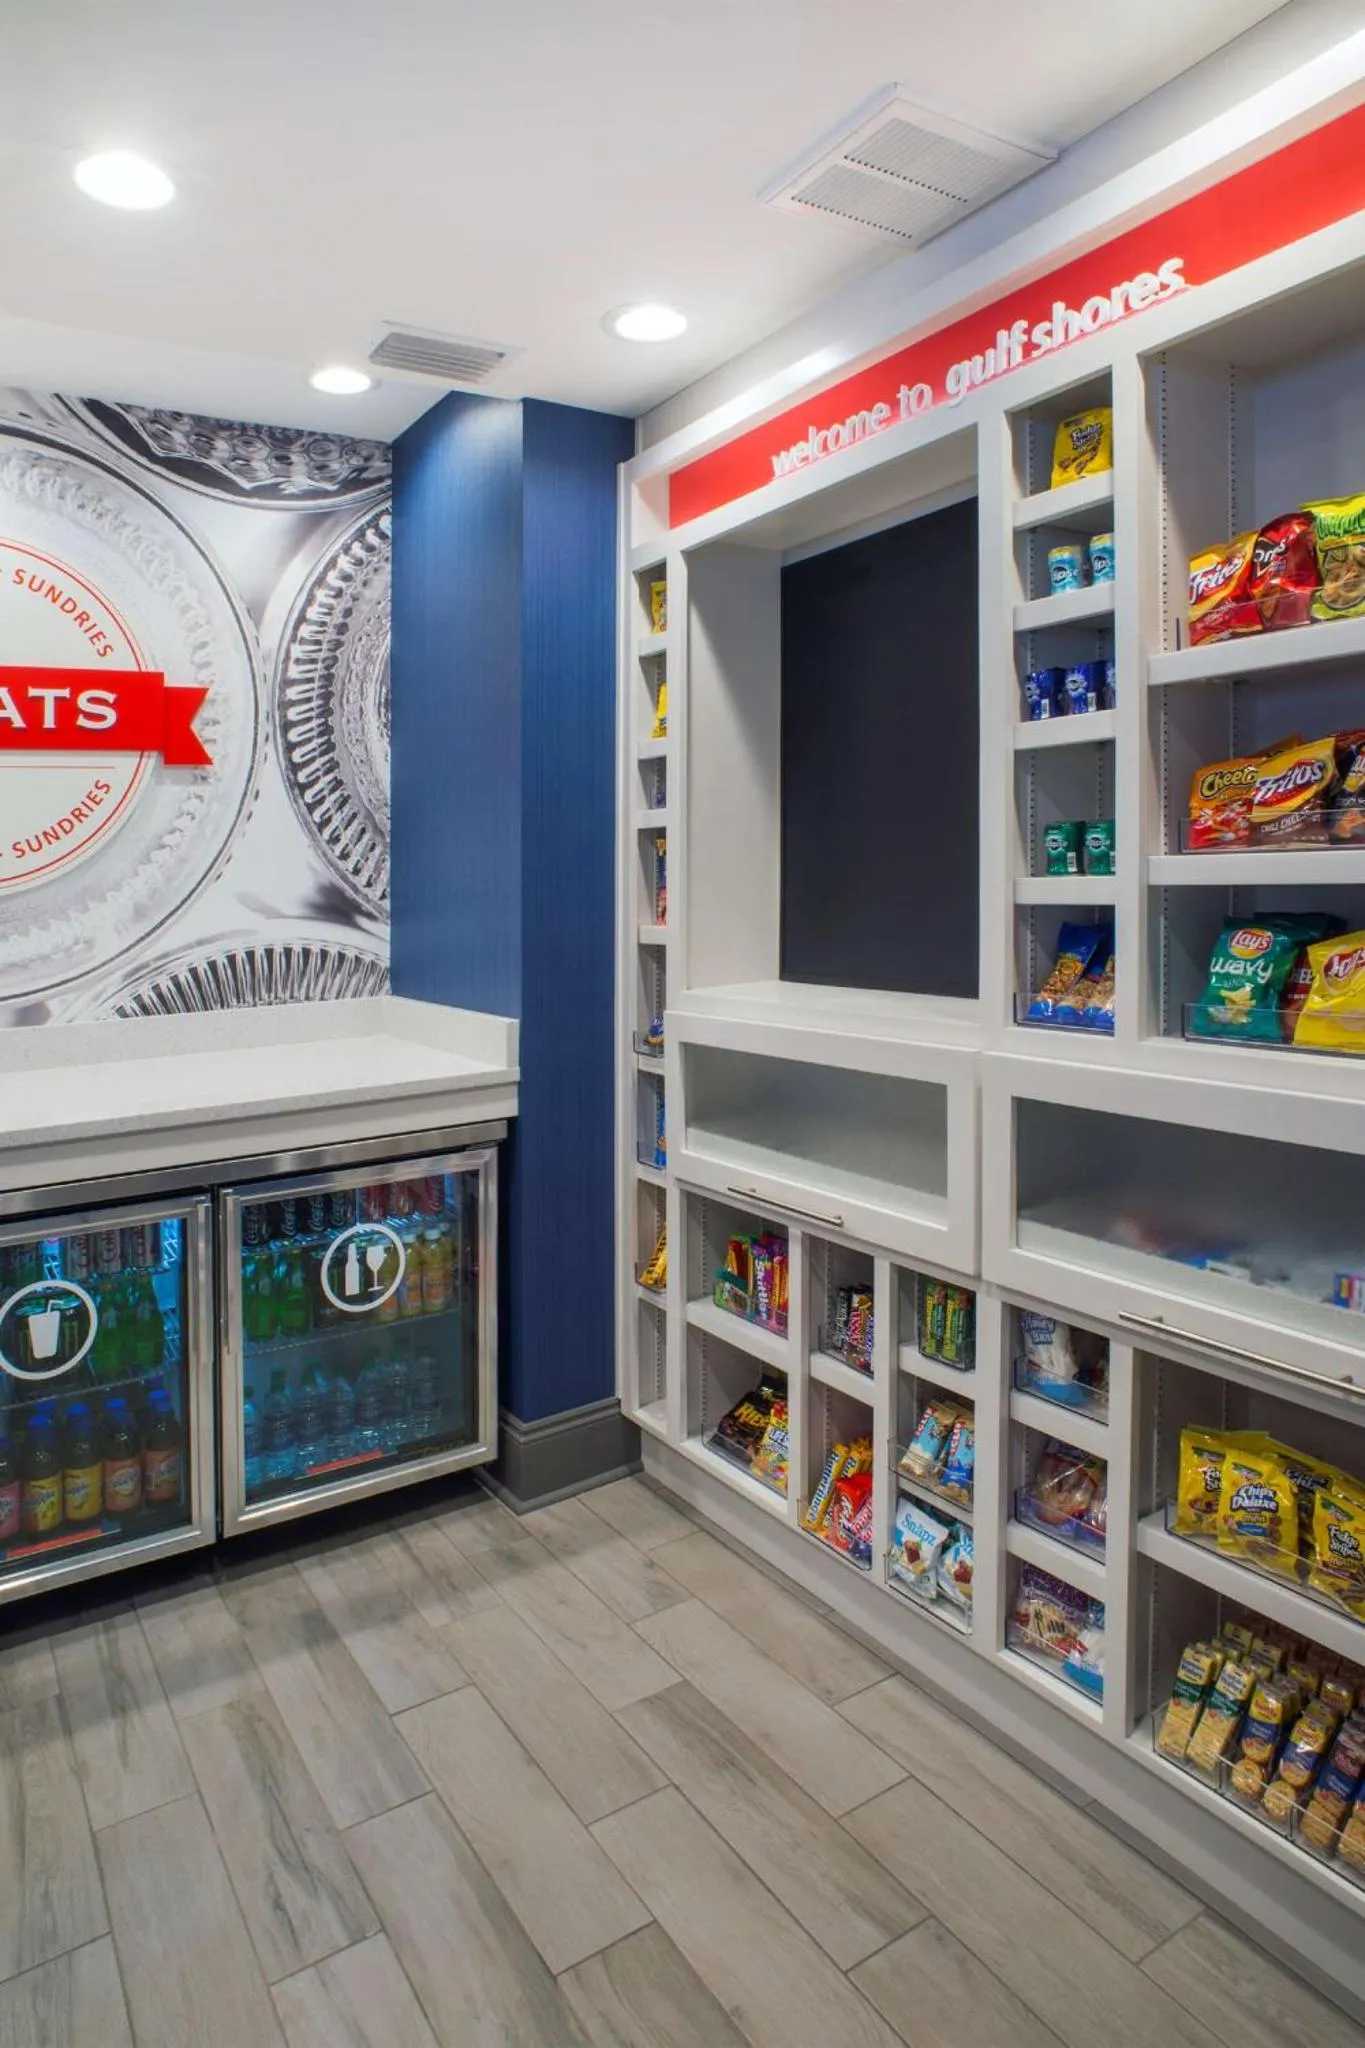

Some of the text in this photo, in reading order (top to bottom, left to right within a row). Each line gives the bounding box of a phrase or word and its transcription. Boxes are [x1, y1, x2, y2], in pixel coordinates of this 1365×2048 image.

[772, 400, 890, 479] welcome
[898, 383, 932, 416] to
[12, 568, 115, 658] SUNDRIES
[1201, 766, 1257, 798] Cheeto
[1254, 761, 1324, 804] Fritos
[12, 779, 112, 859] SUNDRIES
[1231, 930, 1271, 951] Lay's
[1232, 1494, 1278, 1511] Deluxe
[1240, 1484, 1274, 1499] Chips
